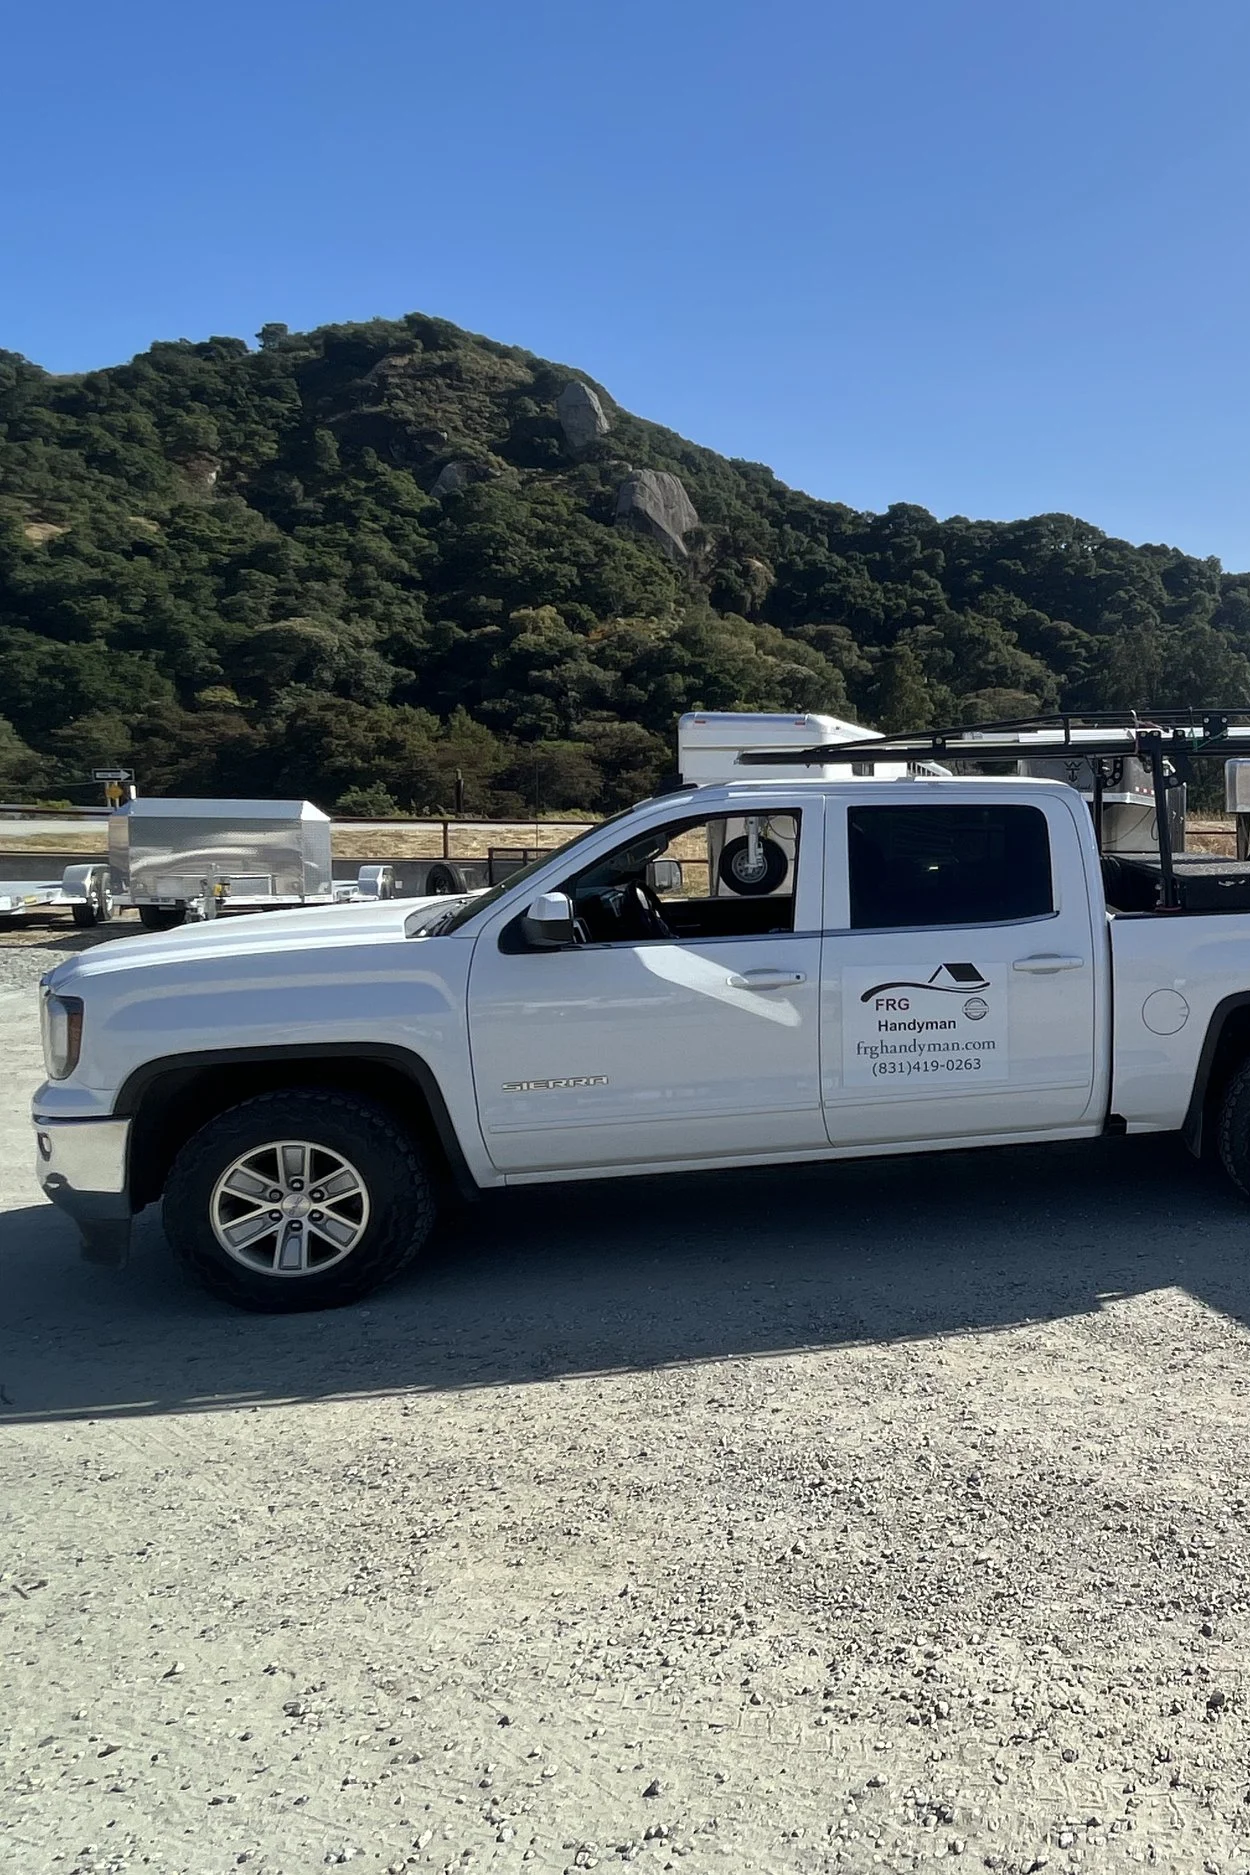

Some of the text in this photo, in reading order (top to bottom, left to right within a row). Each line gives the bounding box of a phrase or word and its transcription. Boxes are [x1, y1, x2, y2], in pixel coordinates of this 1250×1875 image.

[875, 998, 910, 1011] FRG
[878, 1019, 956, 1033] Handyman
[856, 1039, 996, 1059] frghandyman.com
[872, 1058, 981, 1077] (831)419-0263
[502, 1075, 609, 1092] SIERRA
